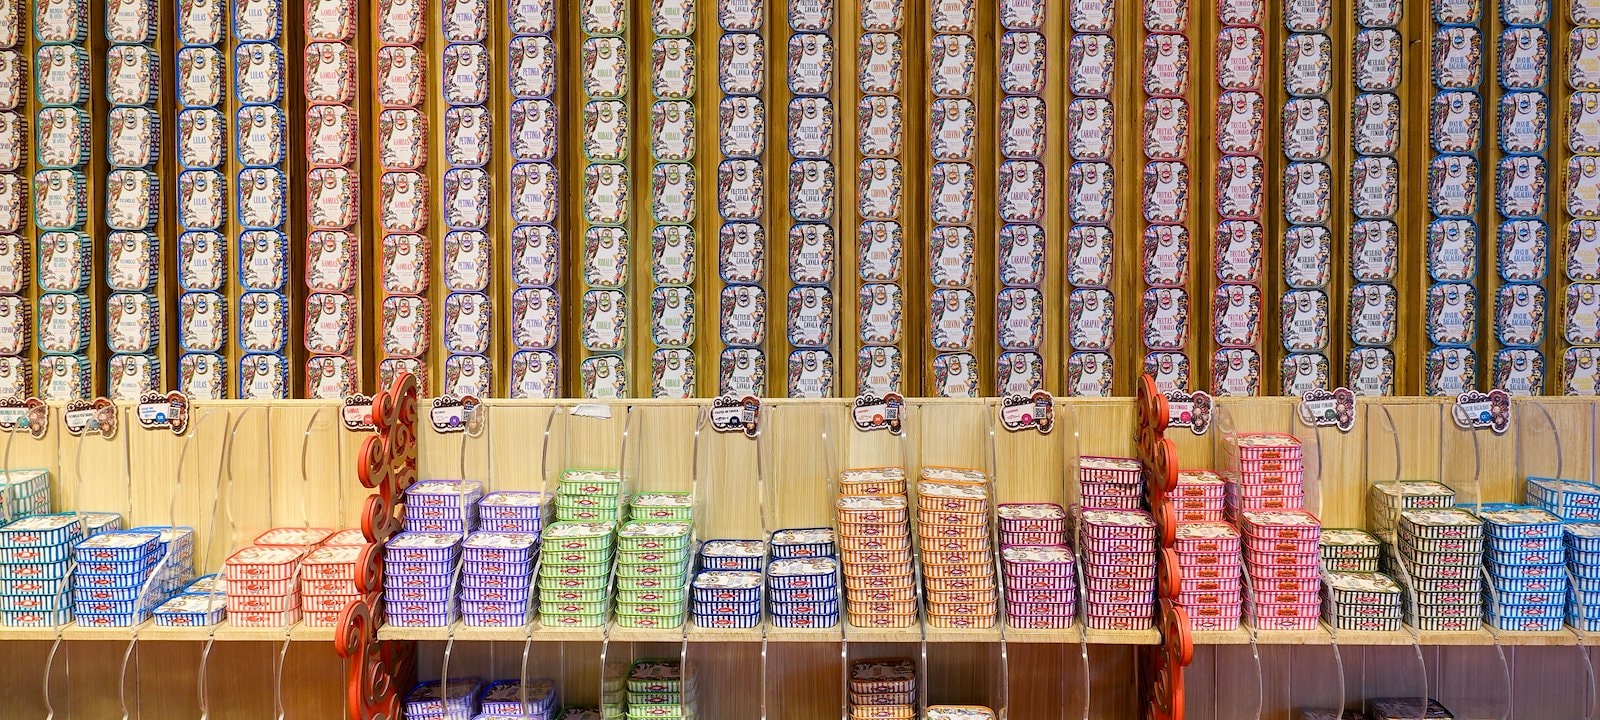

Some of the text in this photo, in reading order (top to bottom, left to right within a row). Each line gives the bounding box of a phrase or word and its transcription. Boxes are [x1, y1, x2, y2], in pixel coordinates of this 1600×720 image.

[522, 4, 538, 13] PETINGA
[944, 2, 960, 11] CORVINA
[1082, 2, 1100, 10] CARAPAU
[249, 9, 262, 17] LULAS
[456, 12, 472, 21] PETINGA
[192, 14, 206, 22] LULAS
[523, 67, 539, 76] PETINGA
[871, 64, 888, 72] CORVINA
[1012, 63, 1030, 72] CARAPAU
[1082, 65, 1100, 74] CARAPAU
[192, 75, 206, 83] LULAS
[250, 71, 263, 79] LULAS
[457, 74, 473, 83] PETINGA
[524, 130, 540, 139] PETINGA
[872, 127, 888, 135] CORVINA
[944, 130, 960, 138] CORVINA
[1012, 128, 1030, 136] CARAPAU
[1081, 129, 1099, 138] CARAPAU
[193, 136, 206, 144] LULAS
[252, 134, 265, 142] LULAS
[459, 136, 475, 145] PETINGA
[871, 189, 888, 197] CORVINA
[1011, 191, 1029, 200] CARAPAU
[253, 196, 266, 204] LULAS
[525, 194, 541, 202] PETINGA
[1081, 193, 1099, 202] CARAPAU
[193, 198, 207, 206] LULAS
[458, 199, 474, 208] PETINGA
[871, 252, 887, 260] CORVINA
[1012, 255, 1030, 264] CARAPAU
[194, 259, 207, 267] LULAS
[255, 258, 268, 266] LULAS
[526, 256, 542, 265] PETINGA
[943, 257, 959, 266] CORVINA
[1079, 256, 1098, 265] CARAPAU
[458, 261, 474, 270] PETINGA
[872, 314, 888, 322] CORVINA
[194, 320, 208, 328] LULAS
[254, 320, 267, 328] LULAS
[526, 319, 542, 328] PETINGA
[1010, 319, 1028, 327] CARAPAU
[1081, 319, 1099, 328] CARAPAU
[458, 324, 474, 332] PETINGA
[193, 380, 207, 388] LULAS
[871, 376, 887, 384] CORVINA
[255, 382, 268, 390] LULAS
[525, 381, 541, 390] PETINGA
[949, 384, 965, 393] CORVINA
[1010, 383, 1028, 391] CARAPAU
[1080, 382, 1098, 391] CARAPAU
